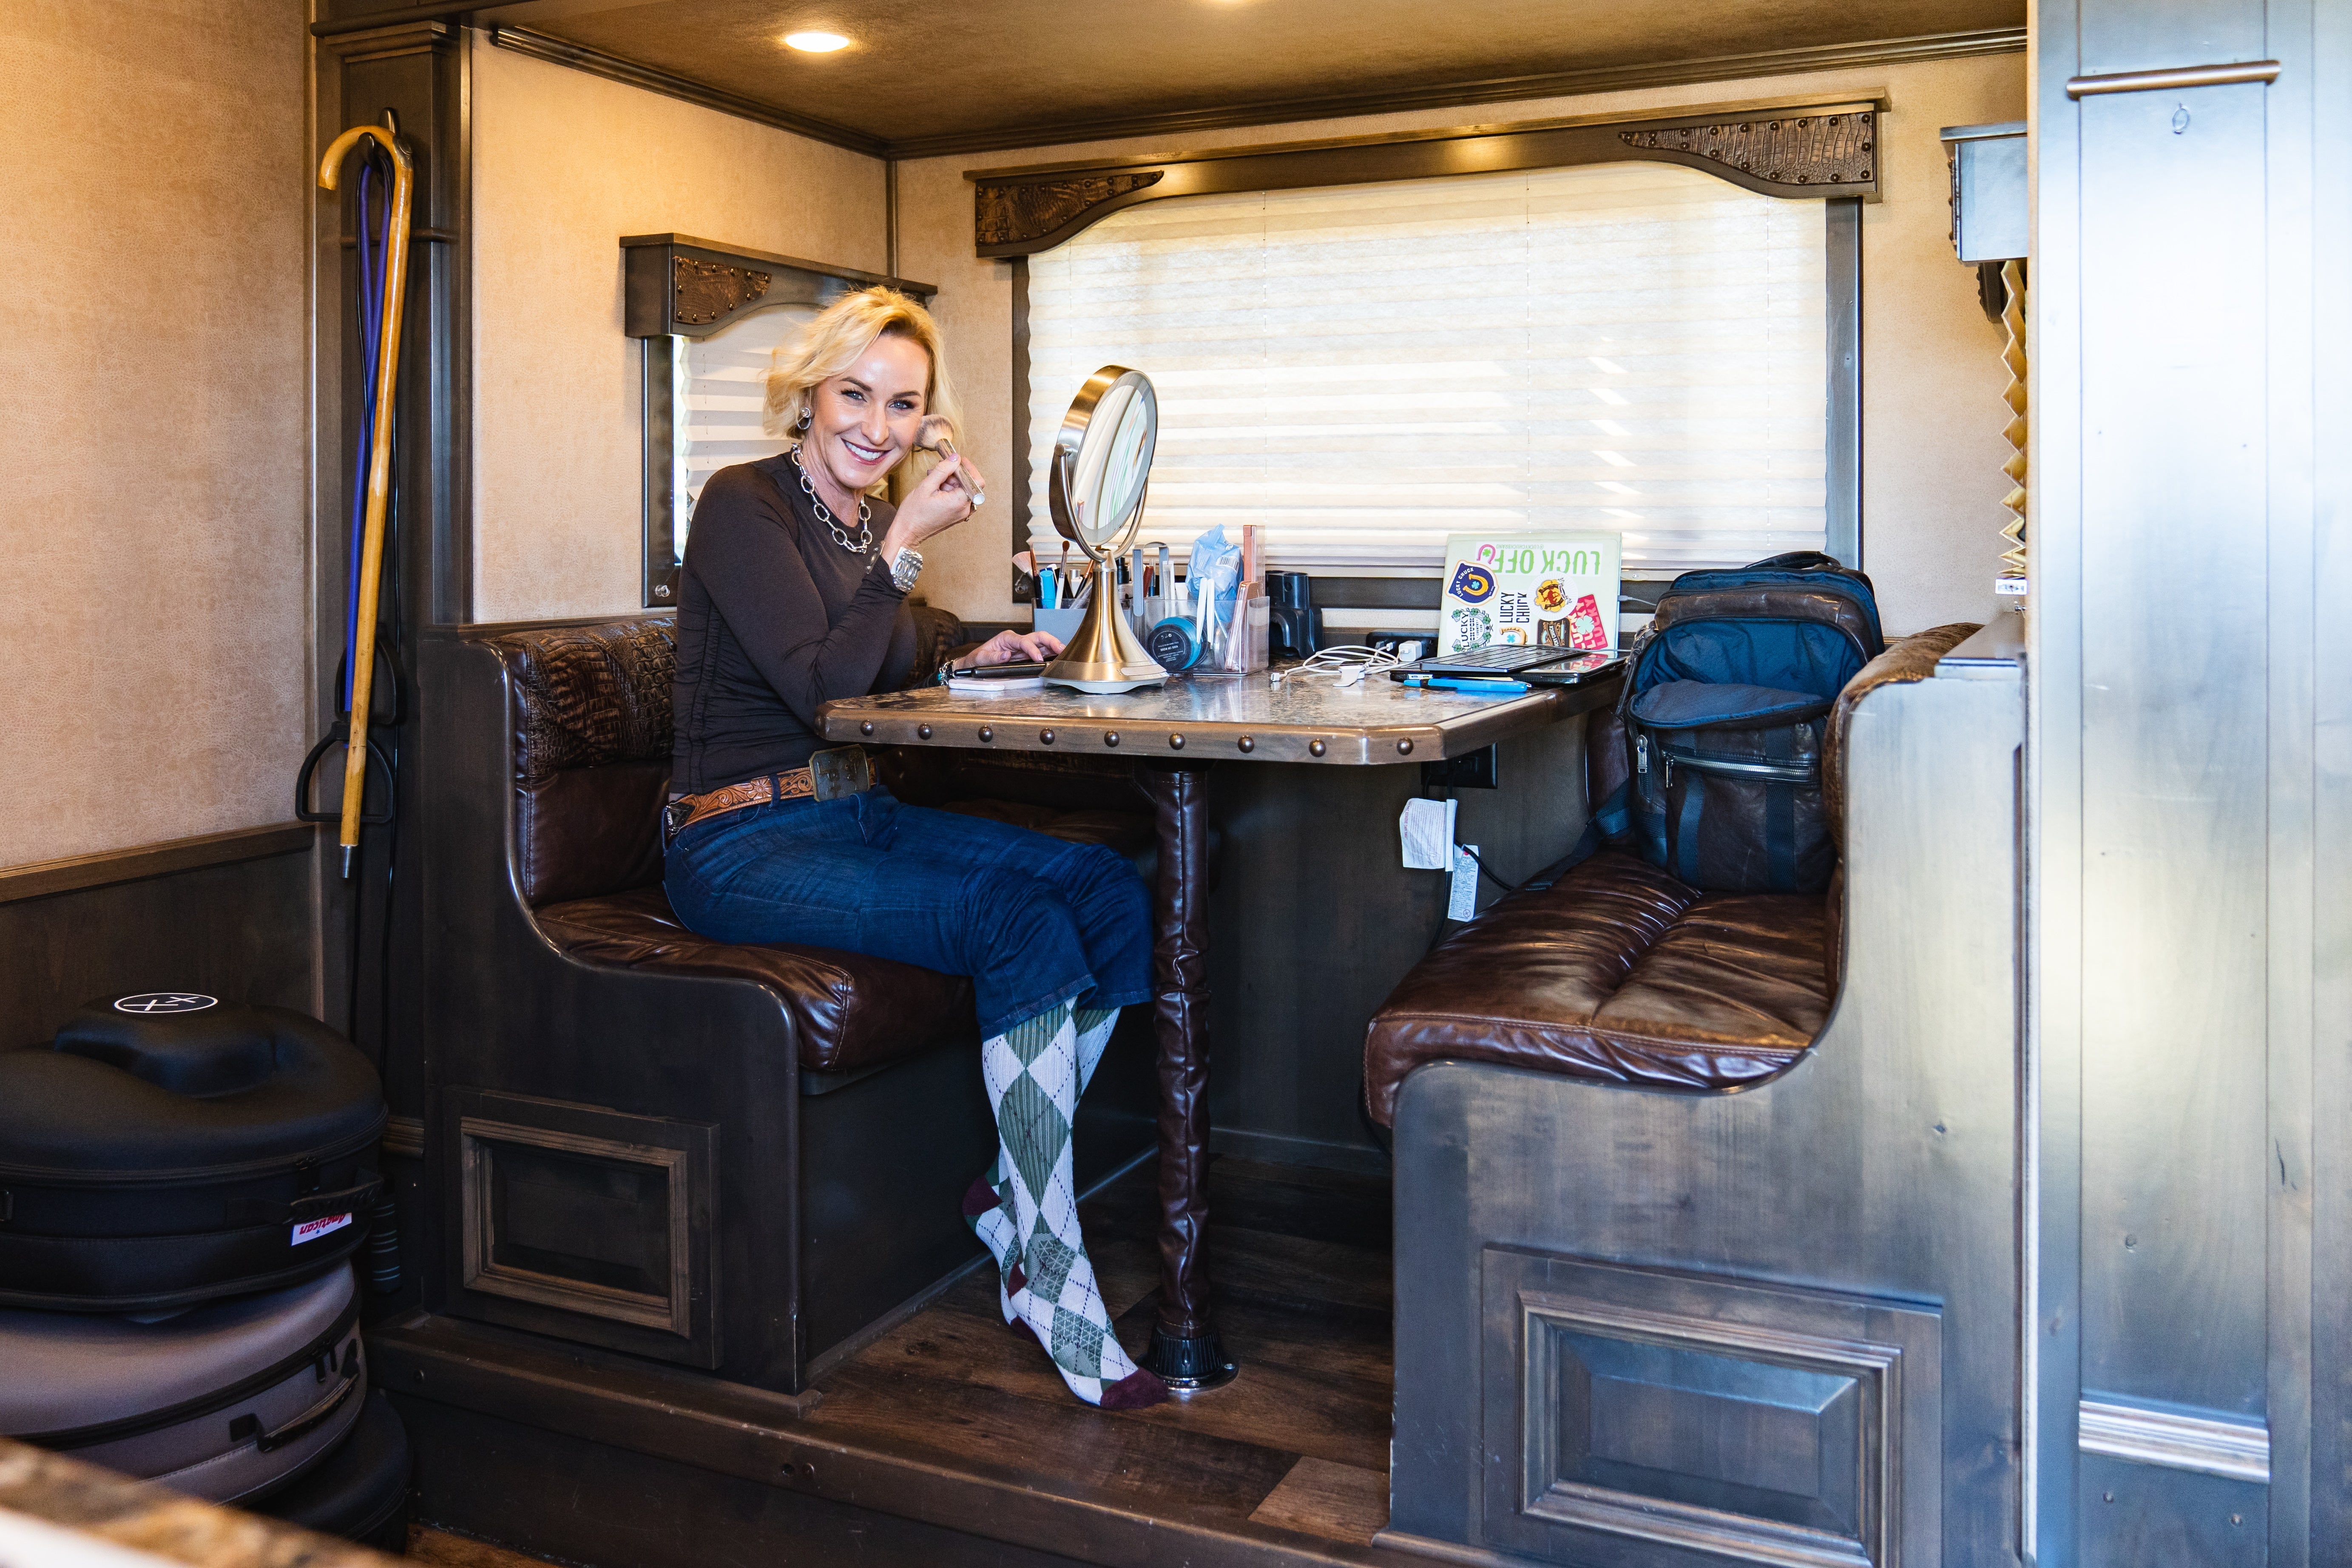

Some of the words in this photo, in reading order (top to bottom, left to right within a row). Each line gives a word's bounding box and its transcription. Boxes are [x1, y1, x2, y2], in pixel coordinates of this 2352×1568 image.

[1458, 567, 1474, 579] CHUCK
[1491, 549, 1534, 574] OFF
[1540, 550, 1600, 575] LUCK
[1455, 581, 1463, 597] LUCKY
[1499, 592, 1514, 623] LUCKY
[1516, 592, 1530, 623] CHUCK
[1461, 613, 1470, 648] LUCKY
[299, 1214, 346, 1235] American
